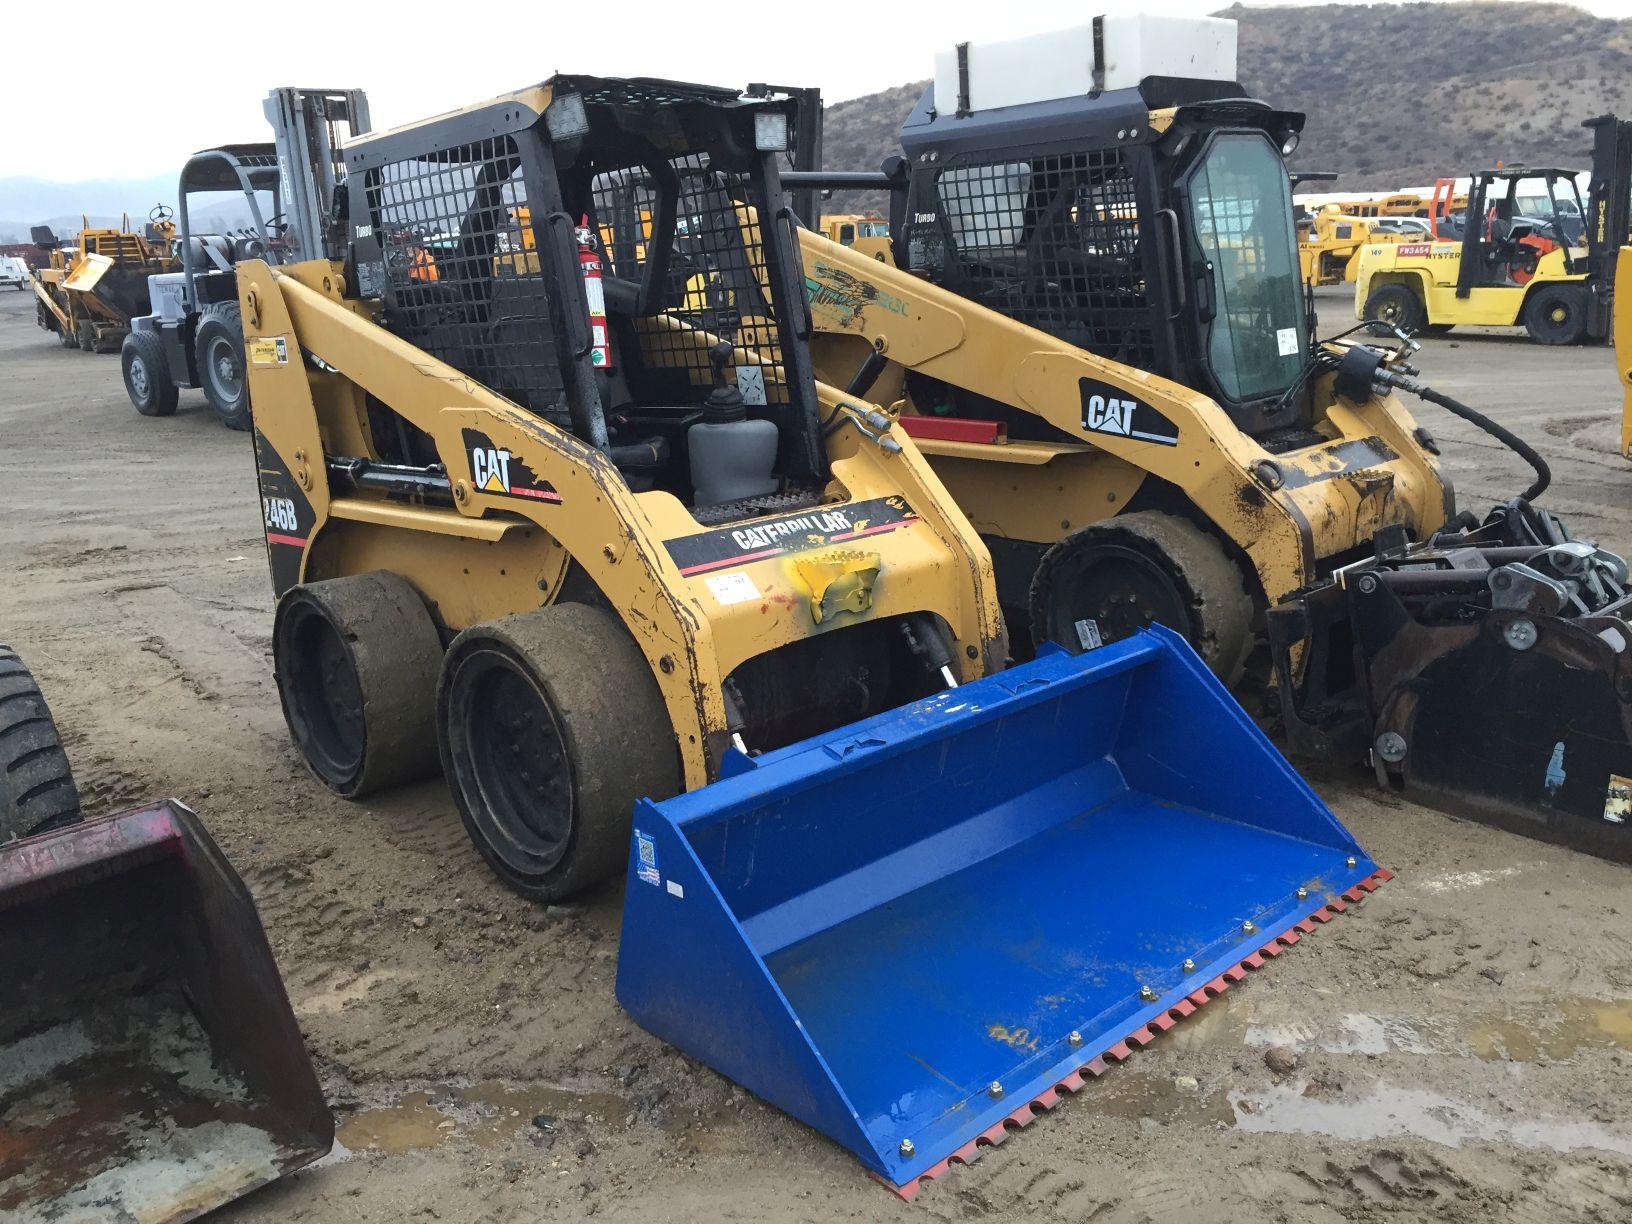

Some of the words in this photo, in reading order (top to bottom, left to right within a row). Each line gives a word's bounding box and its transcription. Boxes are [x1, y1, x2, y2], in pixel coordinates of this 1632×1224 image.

[1425, 252, 1461, 260] HYSTER
[1087, 395, 1137, 436] CAT
[473, 447, 510, 493] CAT
